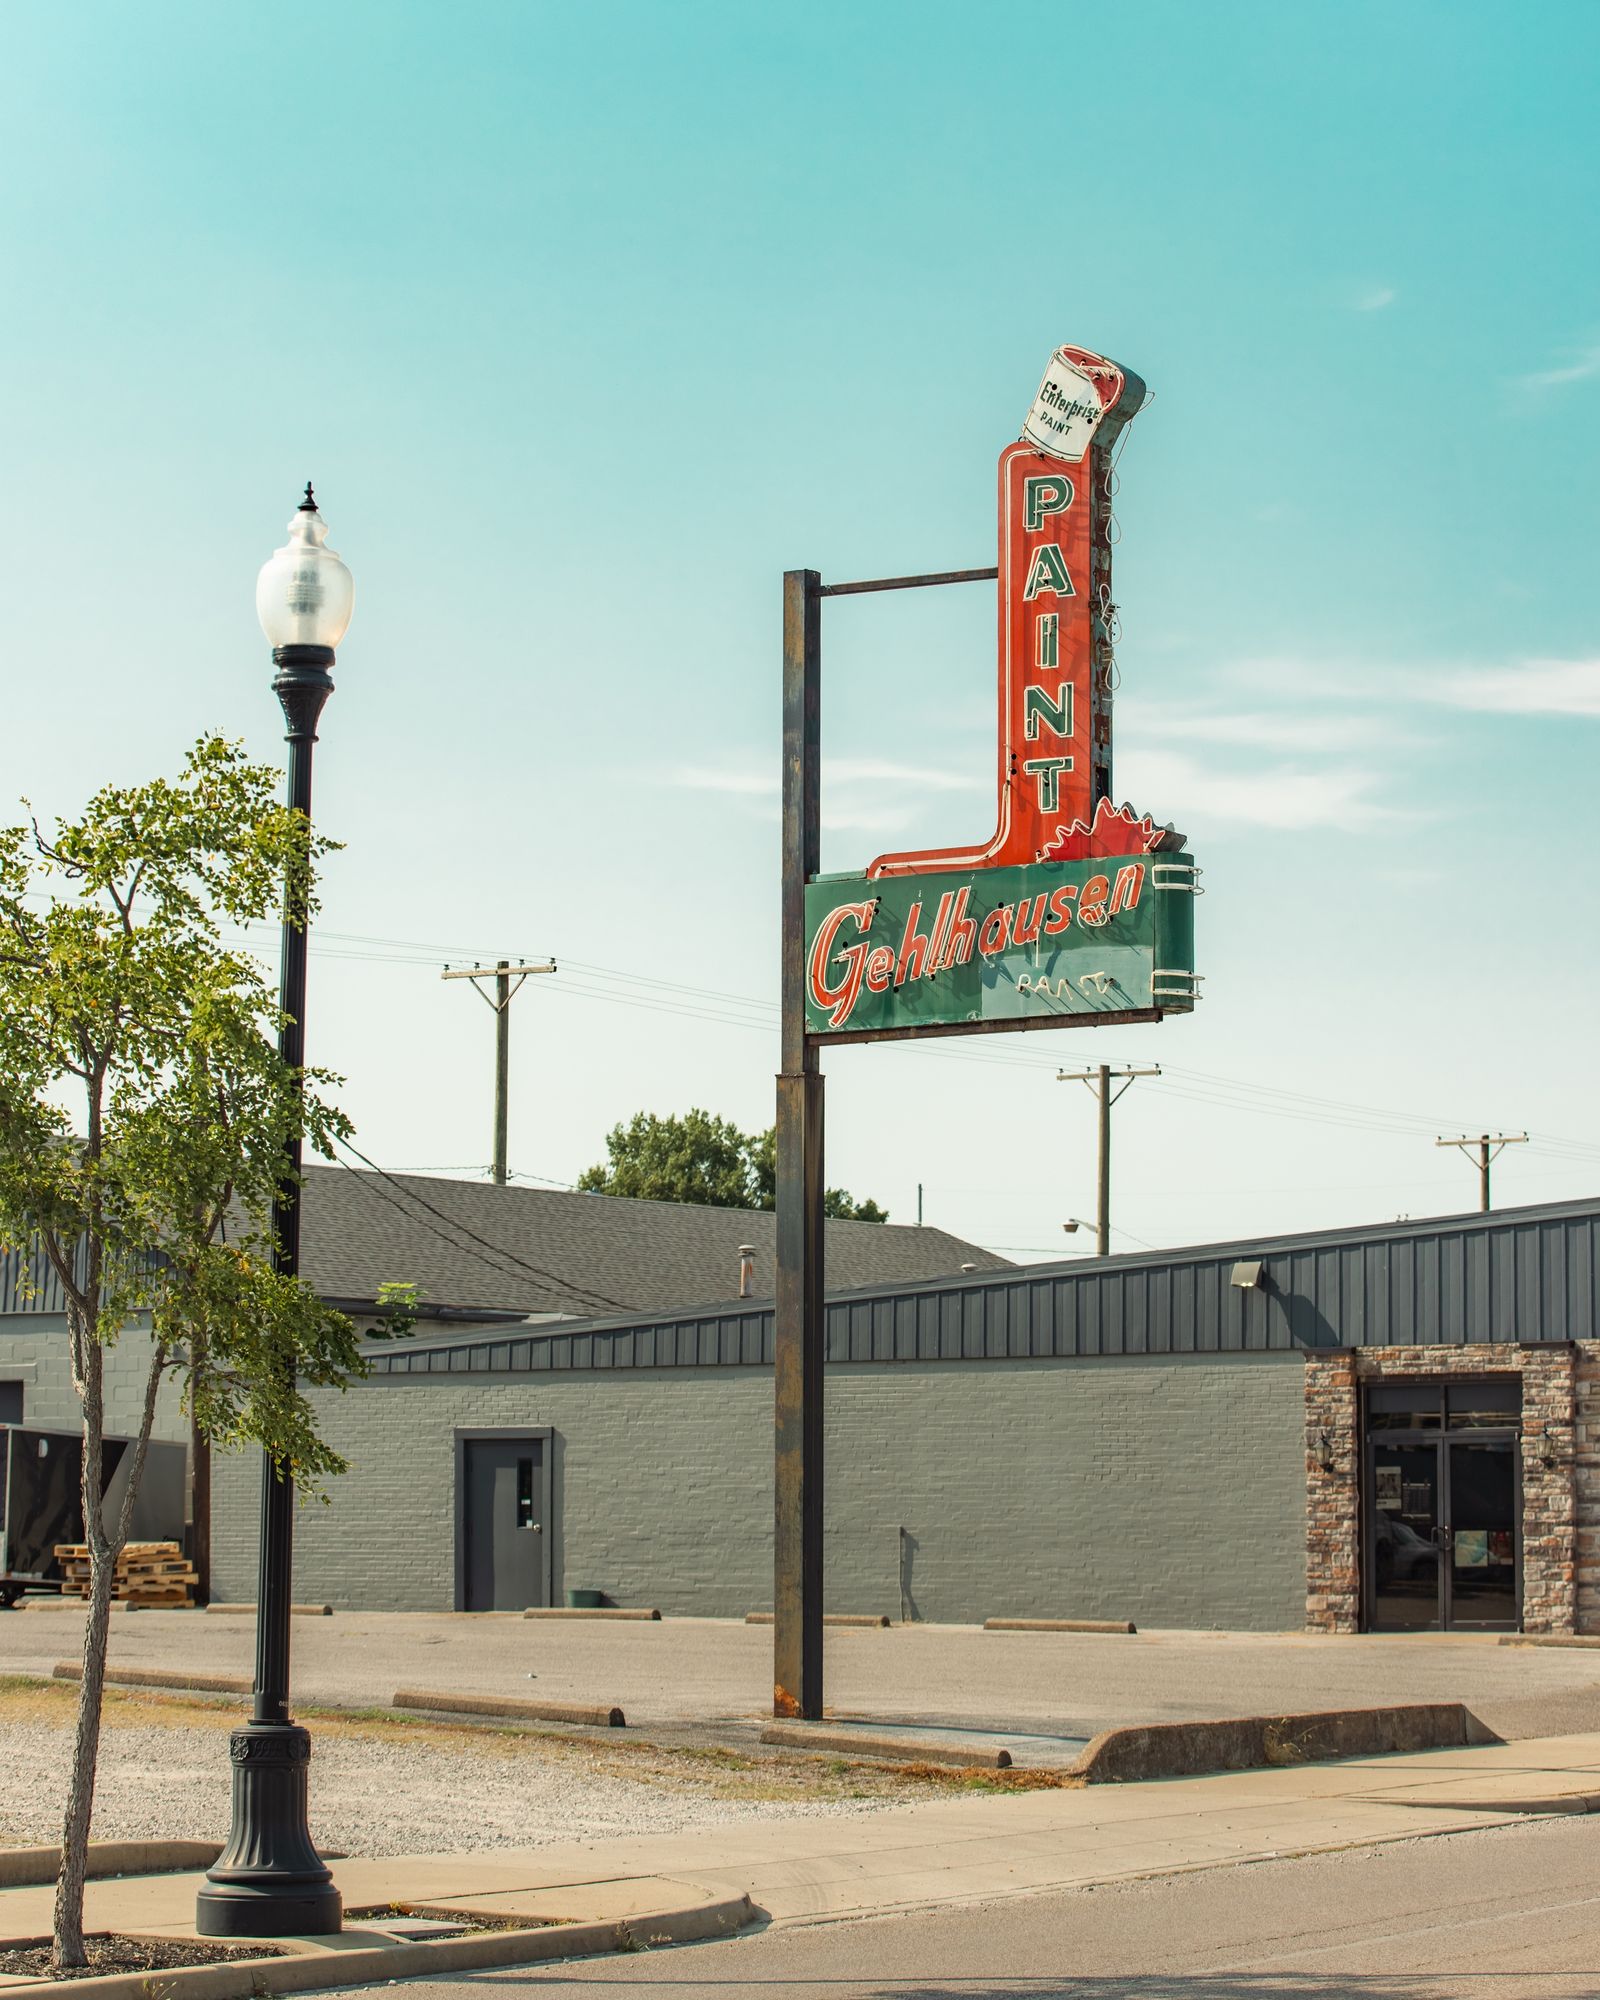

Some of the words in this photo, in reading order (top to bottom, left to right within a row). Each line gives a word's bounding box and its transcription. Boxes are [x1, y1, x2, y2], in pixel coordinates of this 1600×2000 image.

[1040, 380, 1102, 420] Enterprise
[1040, 410, 1073, 435] PAINT
[1022, 474, 1077, 814] PAINT
[806, 862, 1146, 1028] Gehlhausen
